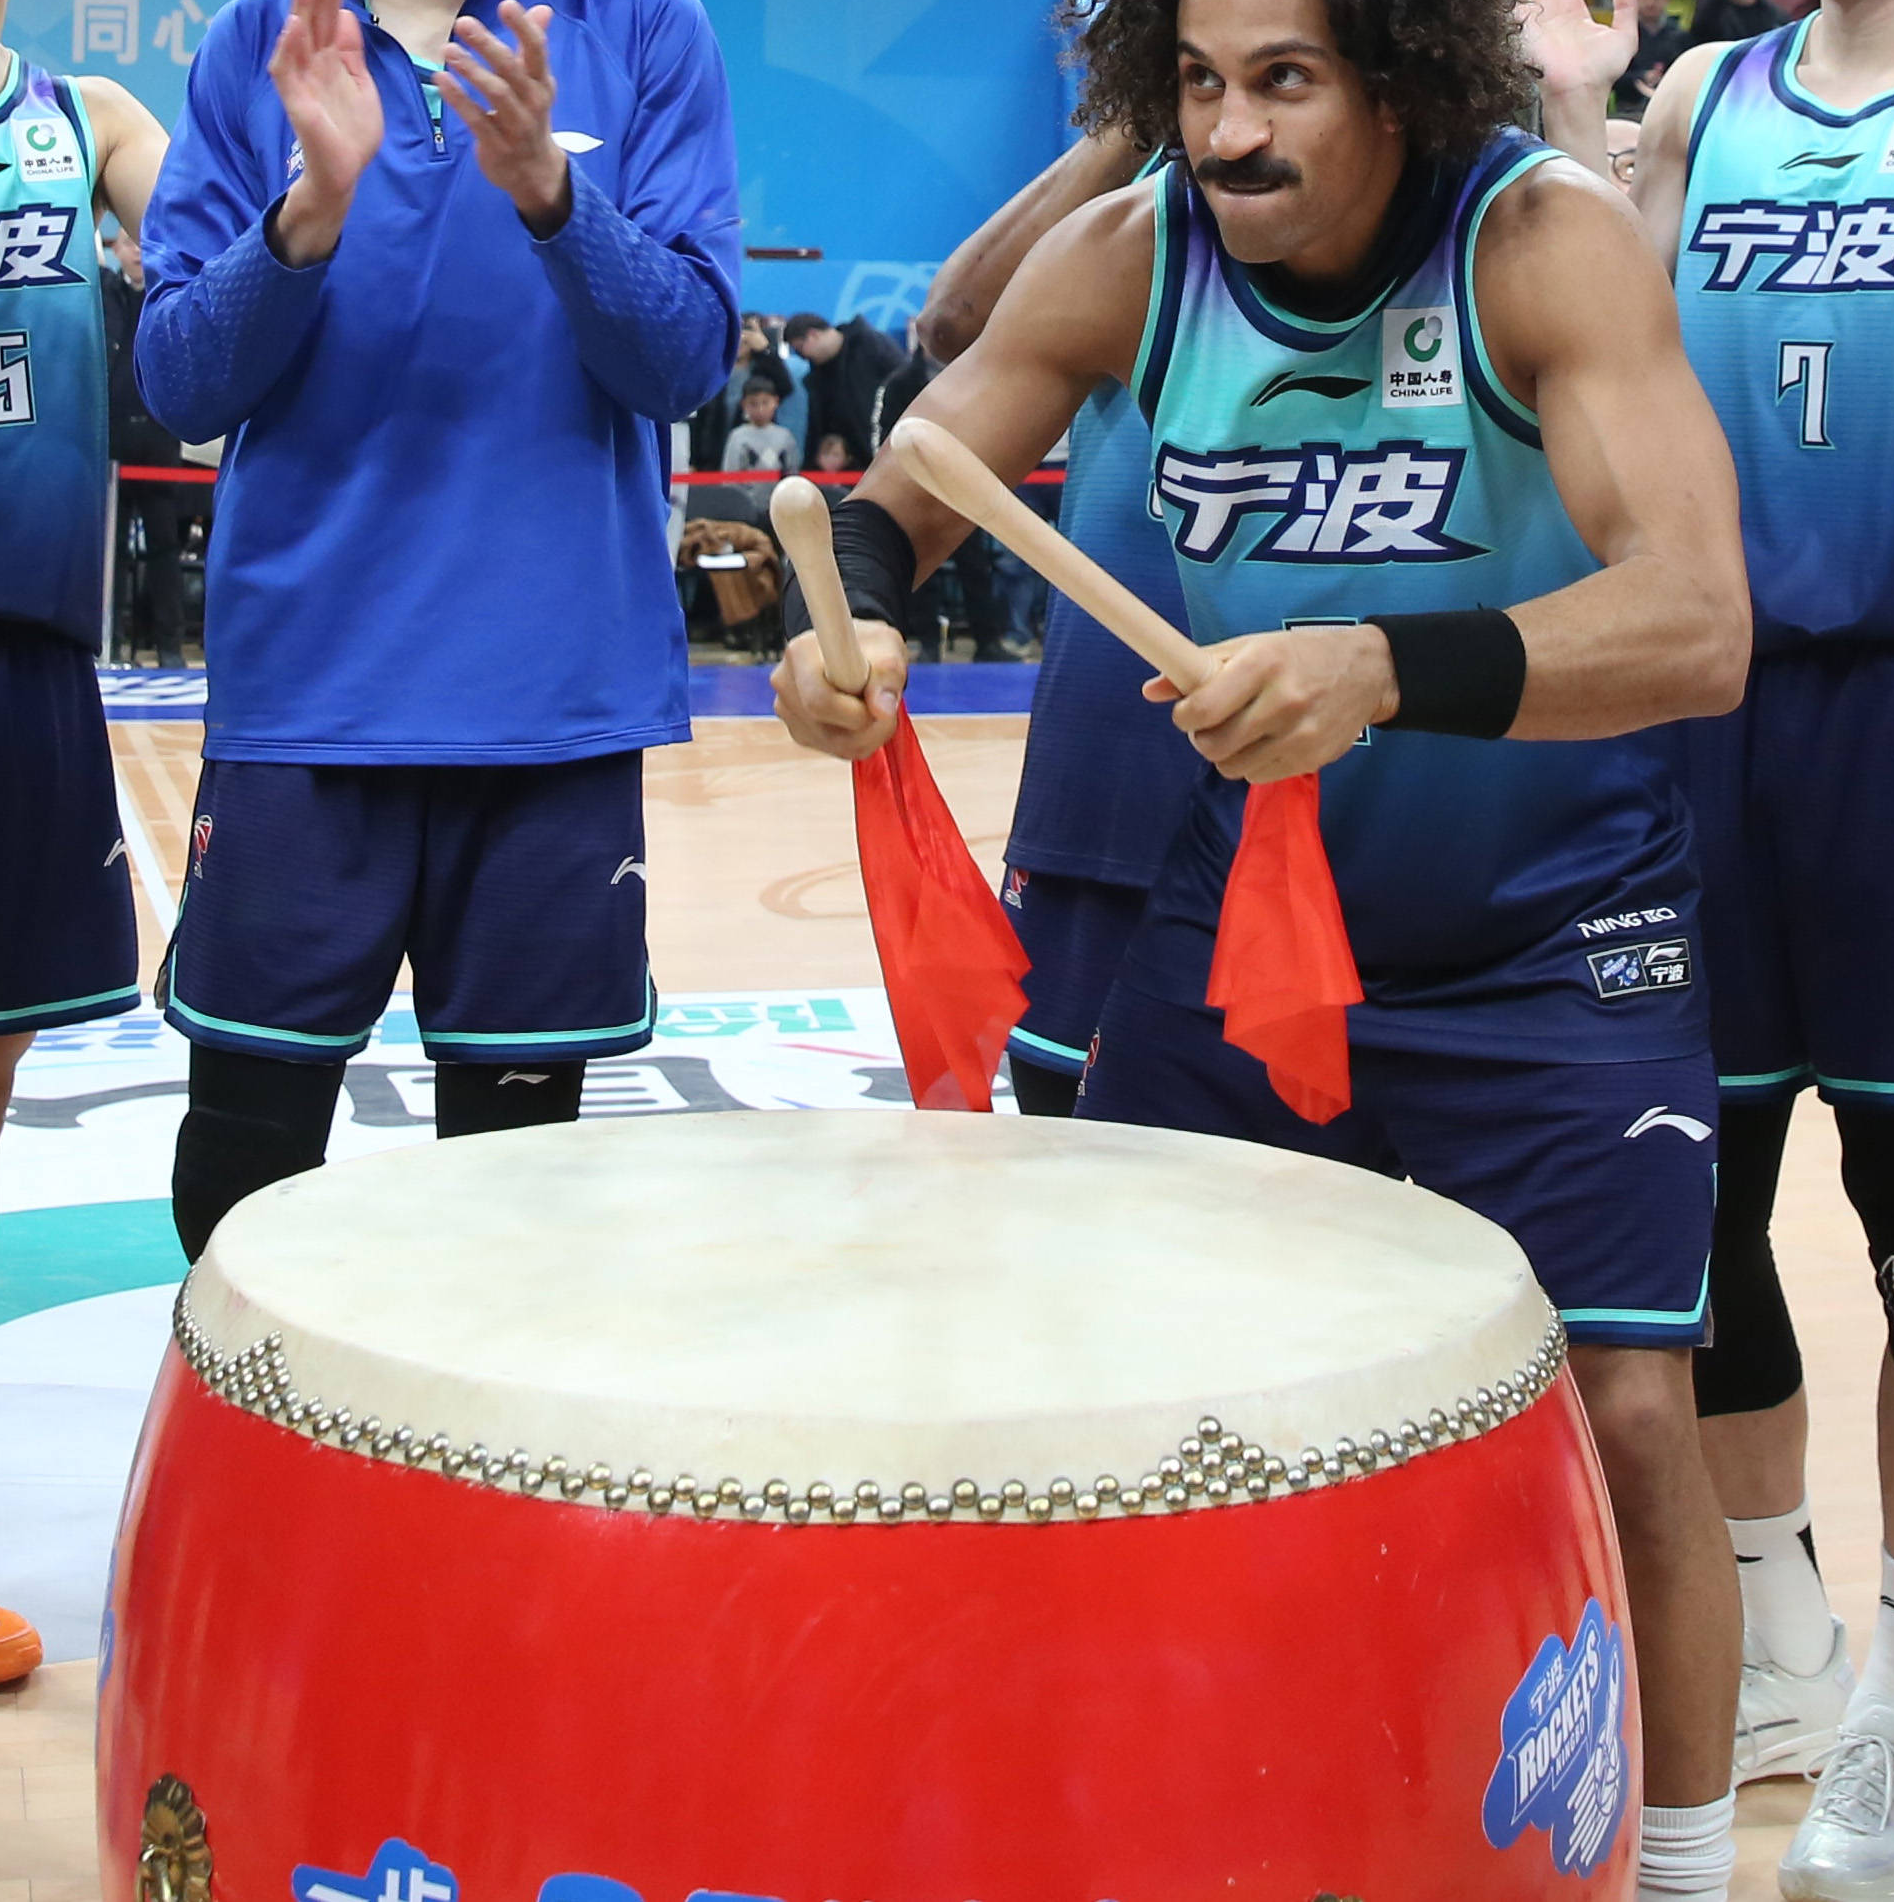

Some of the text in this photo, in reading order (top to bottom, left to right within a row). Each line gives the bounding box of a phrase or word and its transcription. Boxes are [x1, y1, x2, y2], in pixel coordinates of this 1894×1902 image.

[1390, 368, 1453, 387] 中国人寿
[1390, 386, 1454, 398] CHINA LIFE
[1776, 339, 1834, 449] 7
[1157, 443, 1472, 561] 宁波
[1650, 963, 1685, 984] 宁波
[1517, 1628, 1599, 1804] ROCKETS
[1530, 1652, 1566, 1717] 宁波
[1555, 1715, 1586, 1776] NINGBO
